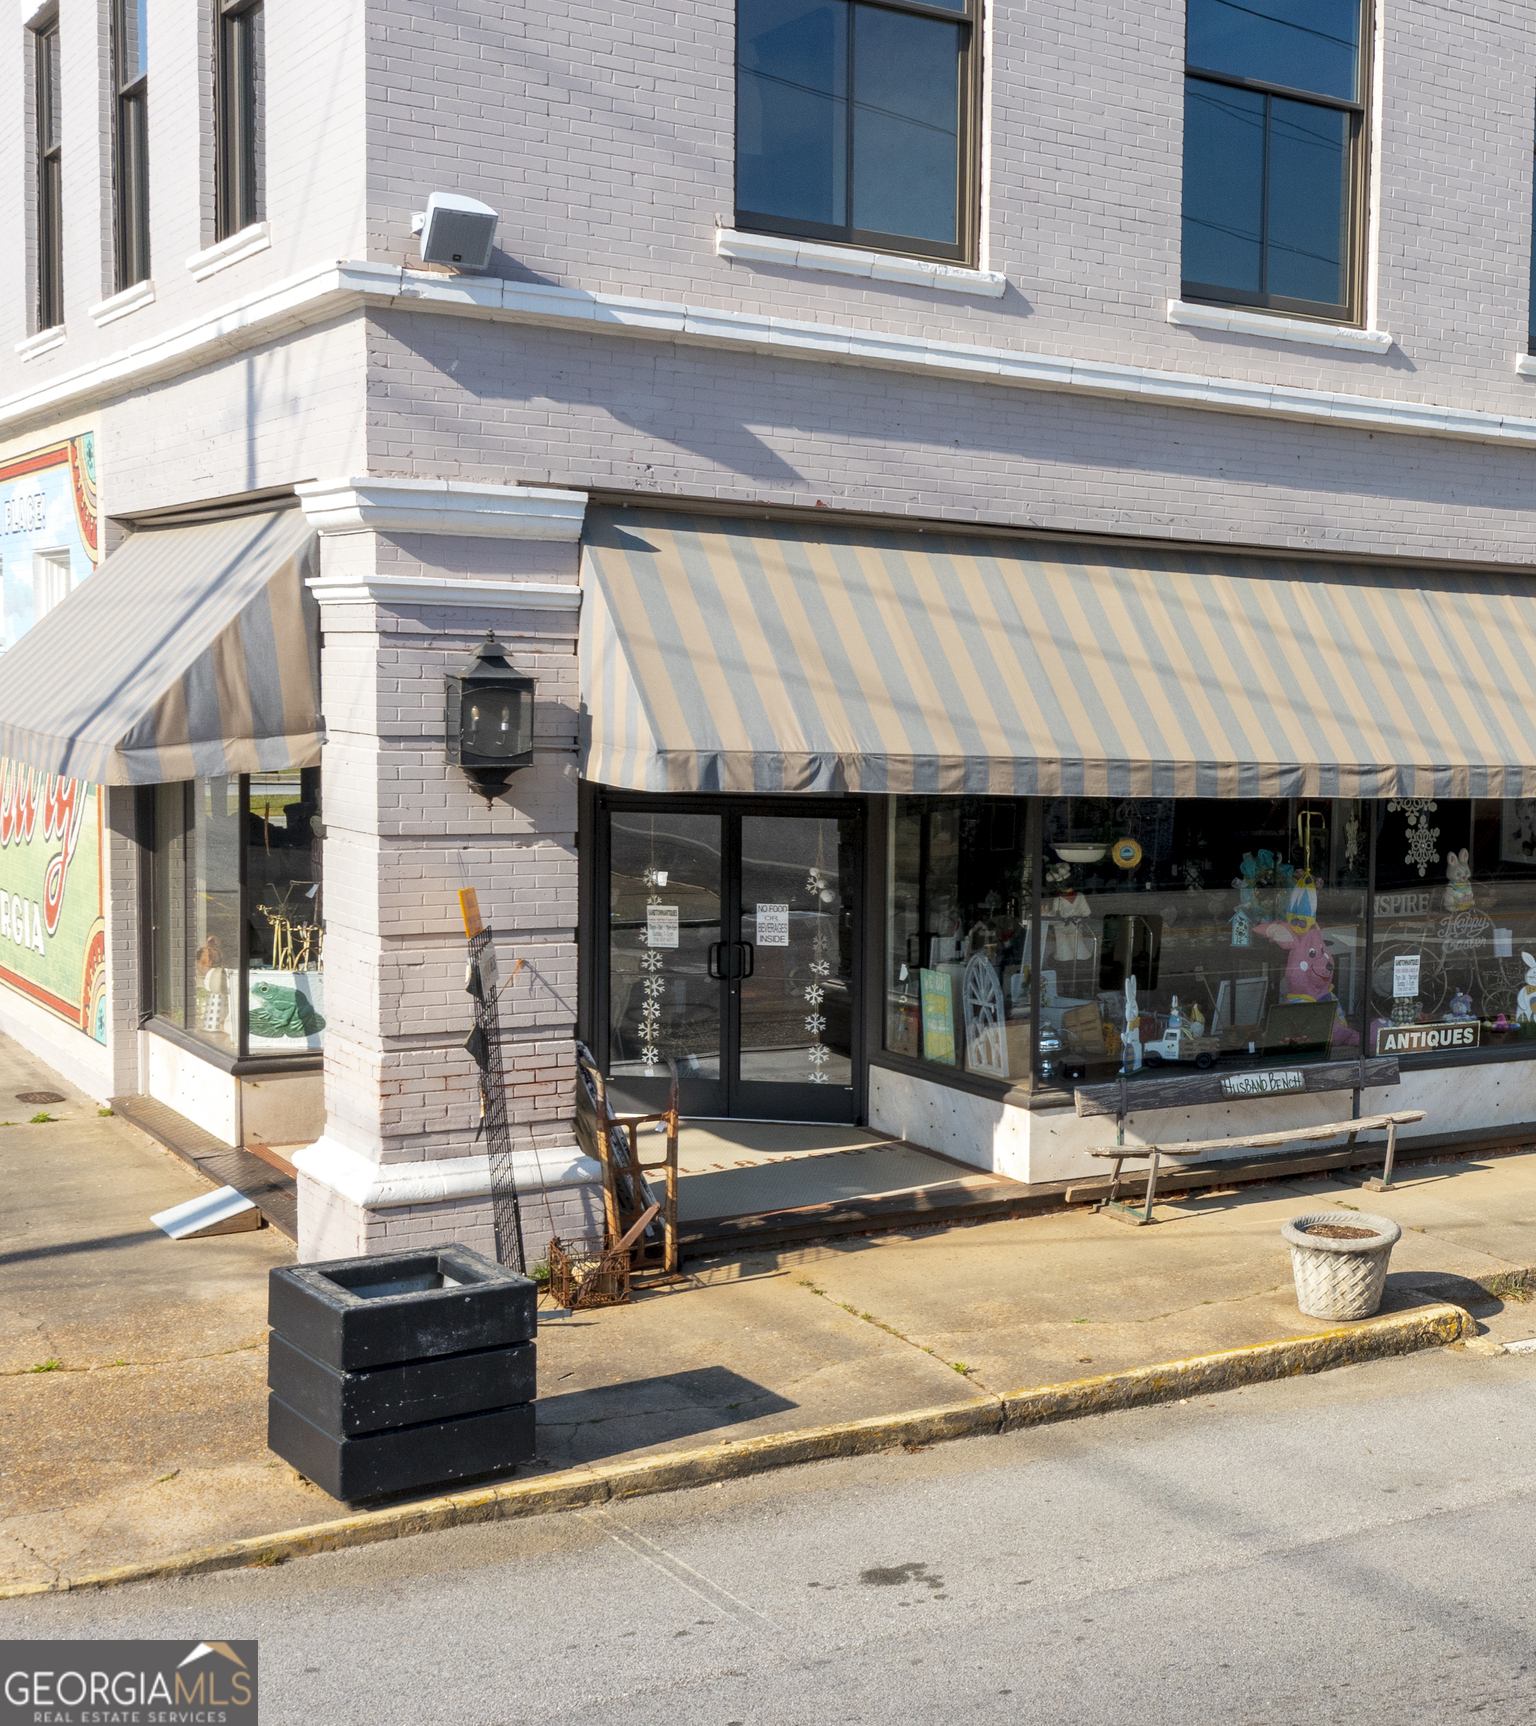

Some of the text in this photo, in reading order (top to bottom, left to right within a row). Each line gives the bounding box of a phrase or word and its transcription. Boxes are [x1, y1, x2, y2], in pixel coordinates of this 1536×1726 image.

[4, 492, 46, 535] PLACE!
[757, 904, 788, 913] NO FOOD
[758, 922, 788, 933] BEVERAGES
[1437, 911, 1490, 938] Happy
[760, 935, 786, 943] INSIDE
[1384, 1027, 1474, 1051] ANTIQUES
[1223, 1070, 1302, 1095] HUSBAND BENCH
